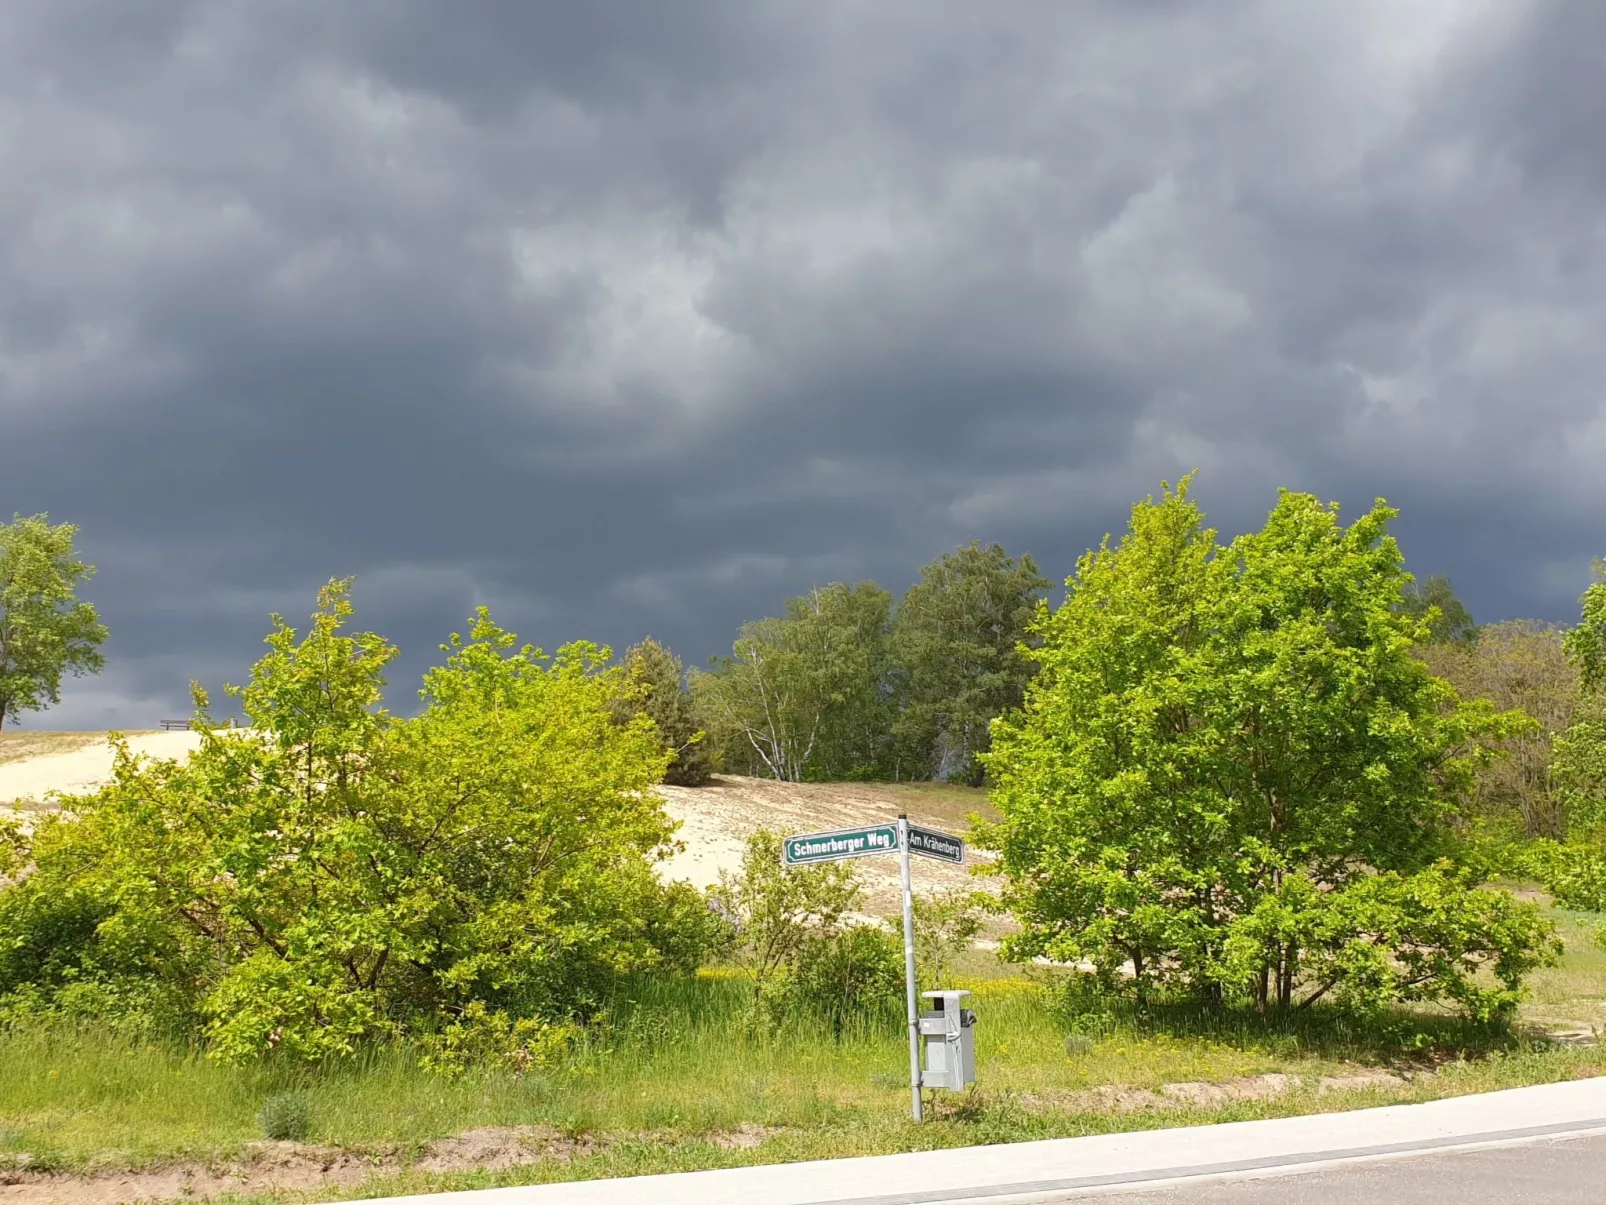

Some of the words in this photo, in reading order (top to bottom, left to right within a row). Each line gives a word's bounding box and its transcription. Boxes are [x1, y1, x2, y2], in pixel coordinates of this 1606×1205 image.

[794, 838, 864, 856] Schmerberger
[867, 832, 890, 848] Weg
[909, 833, 922, 846] Am
[923, 837, 960, 858] Krähenberg
